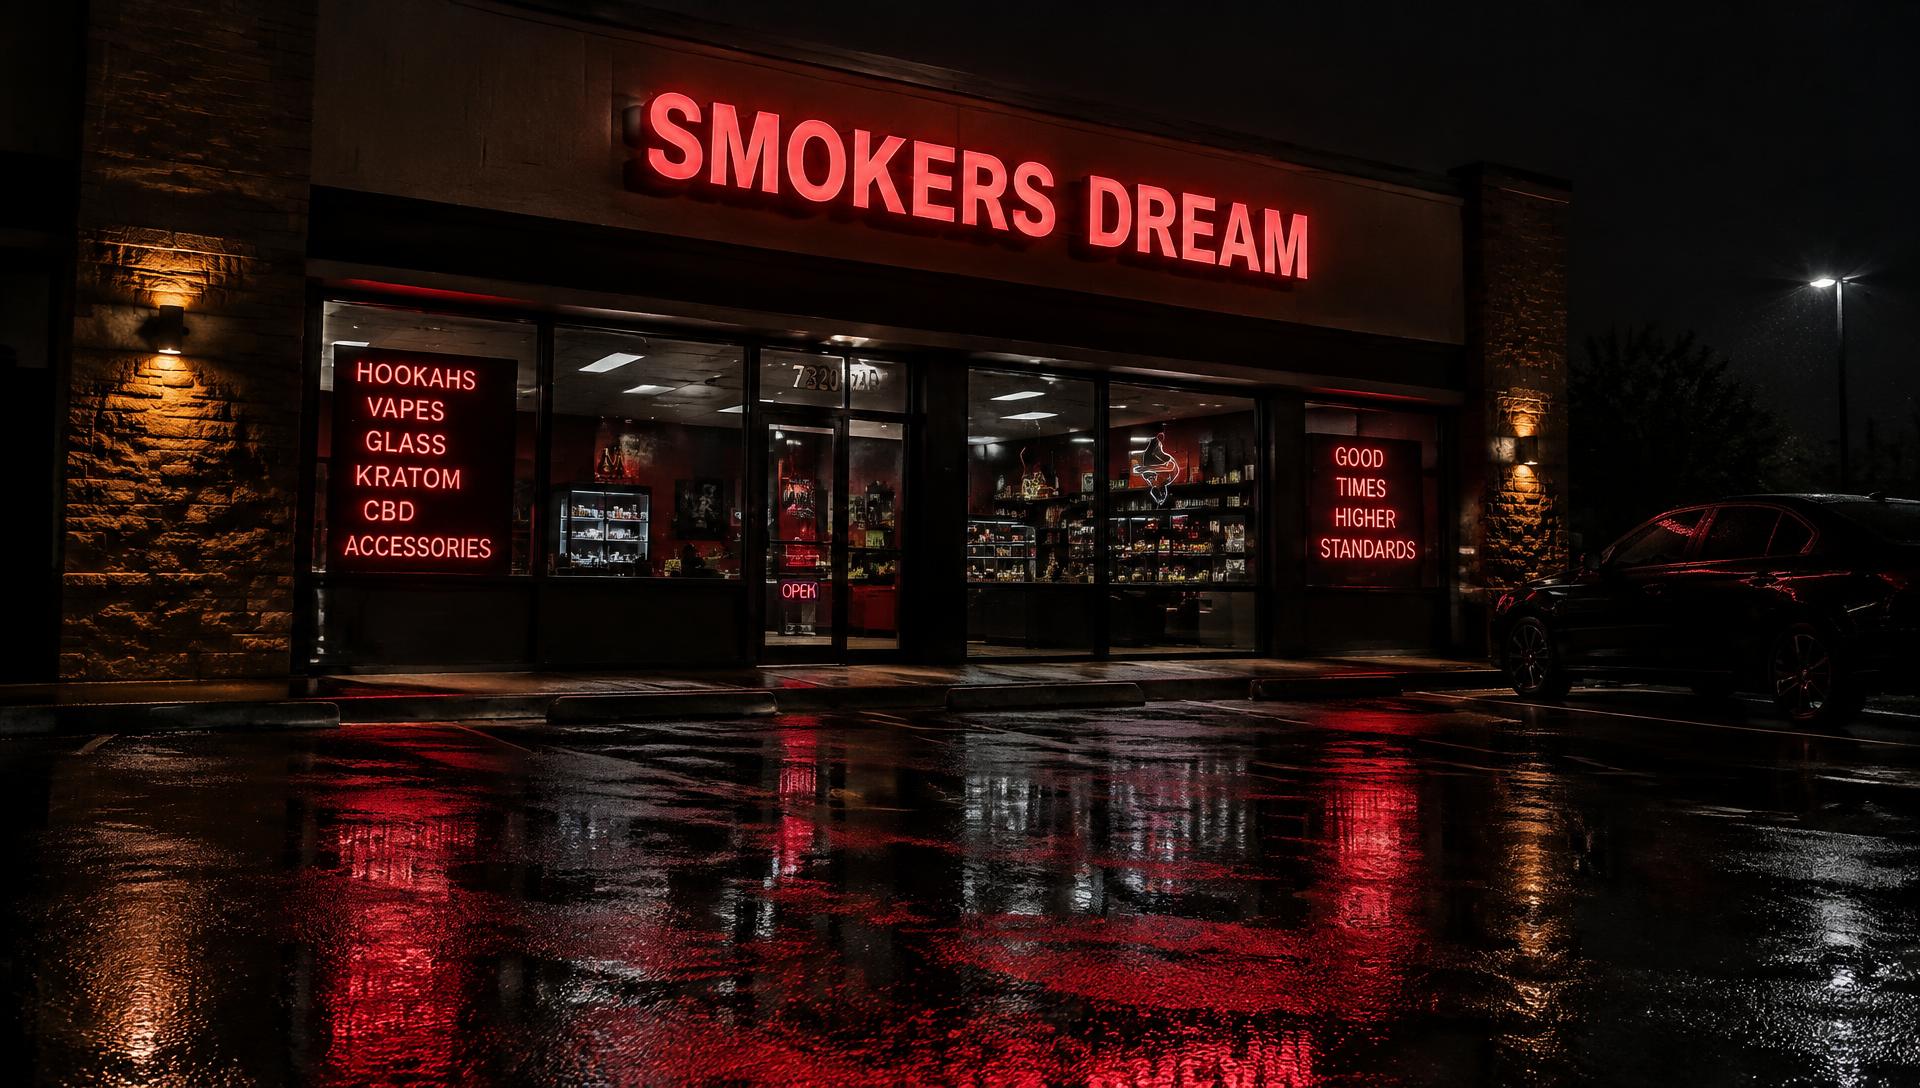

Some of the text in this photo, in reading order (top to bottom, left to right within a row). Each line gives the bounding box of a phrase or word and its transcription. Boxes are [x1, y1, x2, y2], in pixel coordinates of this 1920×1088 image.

[647, 91, 1309, 281] SMOKERS DREAM
[356, 361, 477, 391] HOOKAHS
[367, 396, 445, 422] VAPES
[365, 430, 446, 455] GLASS
[1335, 446, 1384, 468] GOOD
[355, 464, 461, 490] KRATOM
[1335, 476, 1387, 498] TIMES
[364, 499, 414, 522] CBD
[1335, 507, 1396, 529] HIGHER
[344, 535, 492, 559] ACCESSORIES
[1320, 538, 1416, 560] STANDARDS
